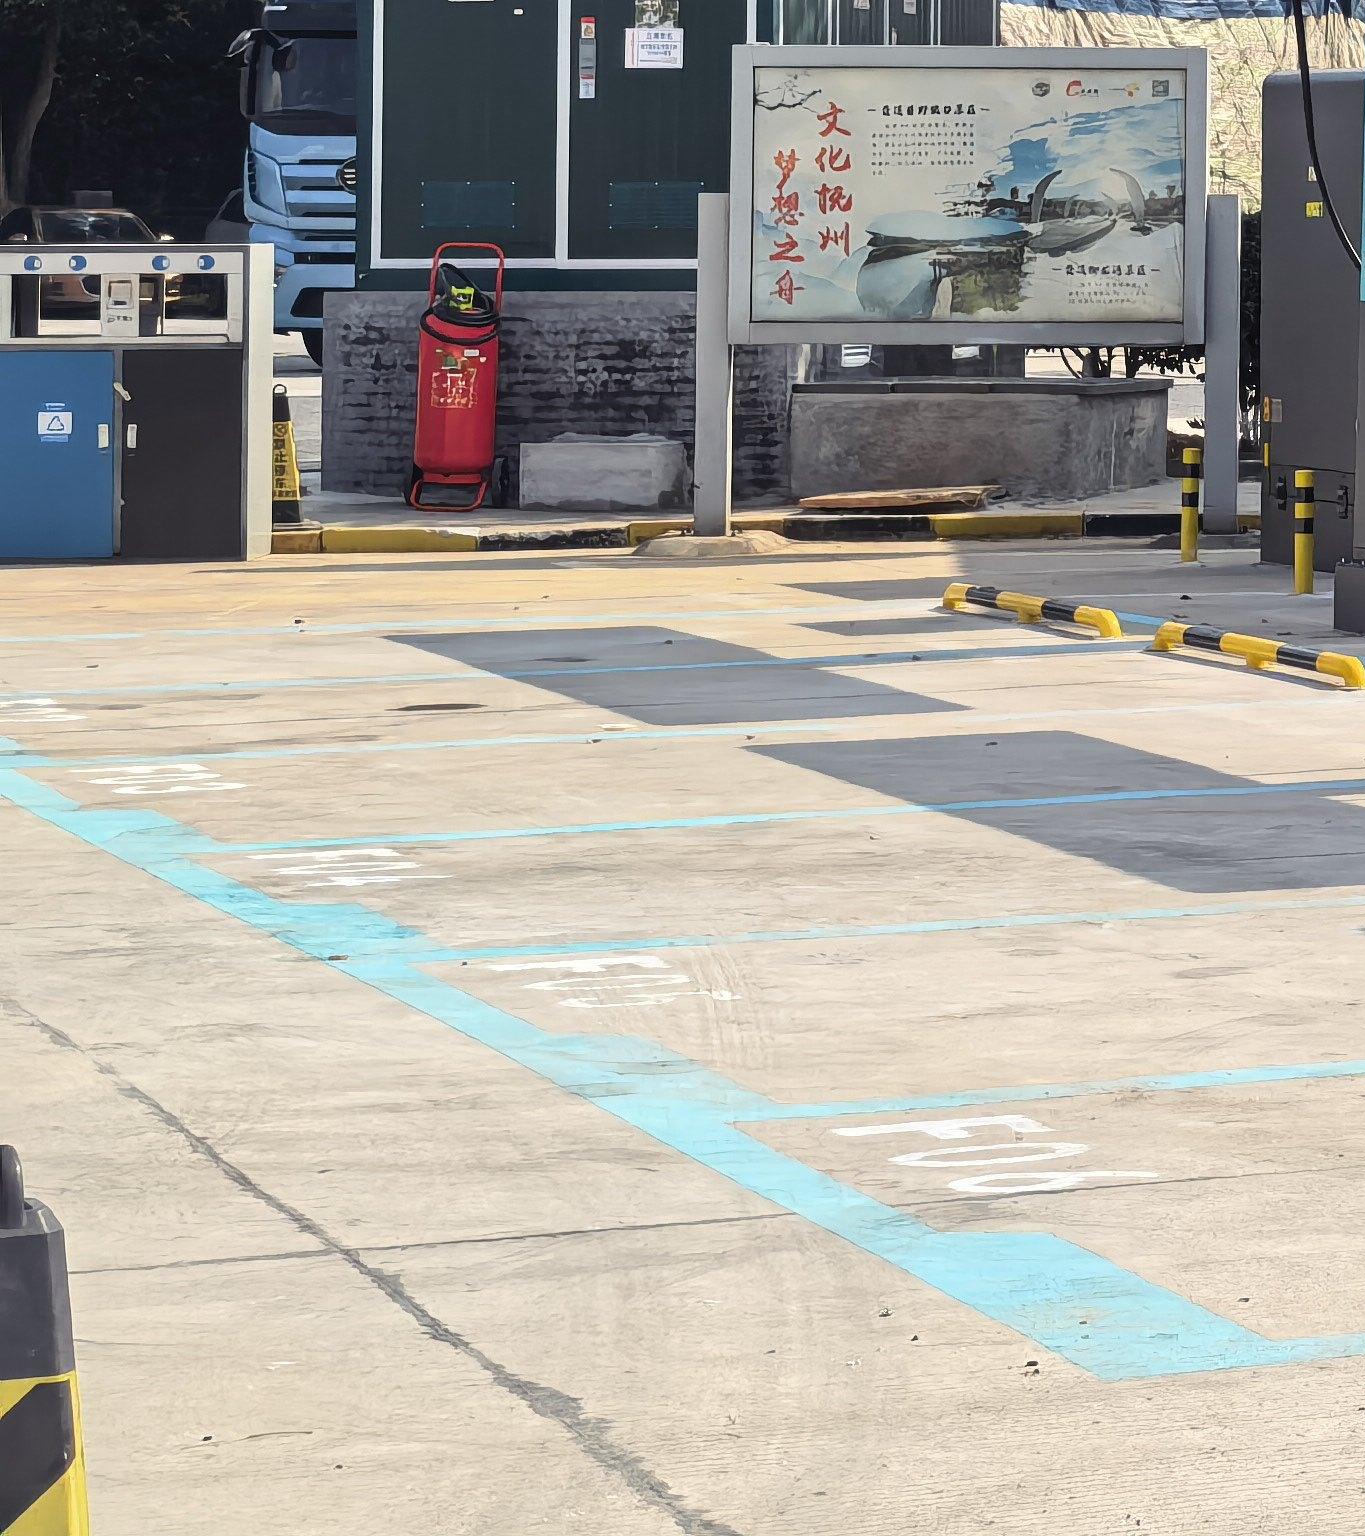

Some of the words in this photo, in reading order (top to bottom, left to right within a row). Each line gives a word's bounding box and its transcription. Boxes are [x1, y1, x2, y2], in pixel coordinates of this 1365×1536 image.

[814, 101, 853, 257] 文化抚州
[831, 1114, 1159, 1194] F06
